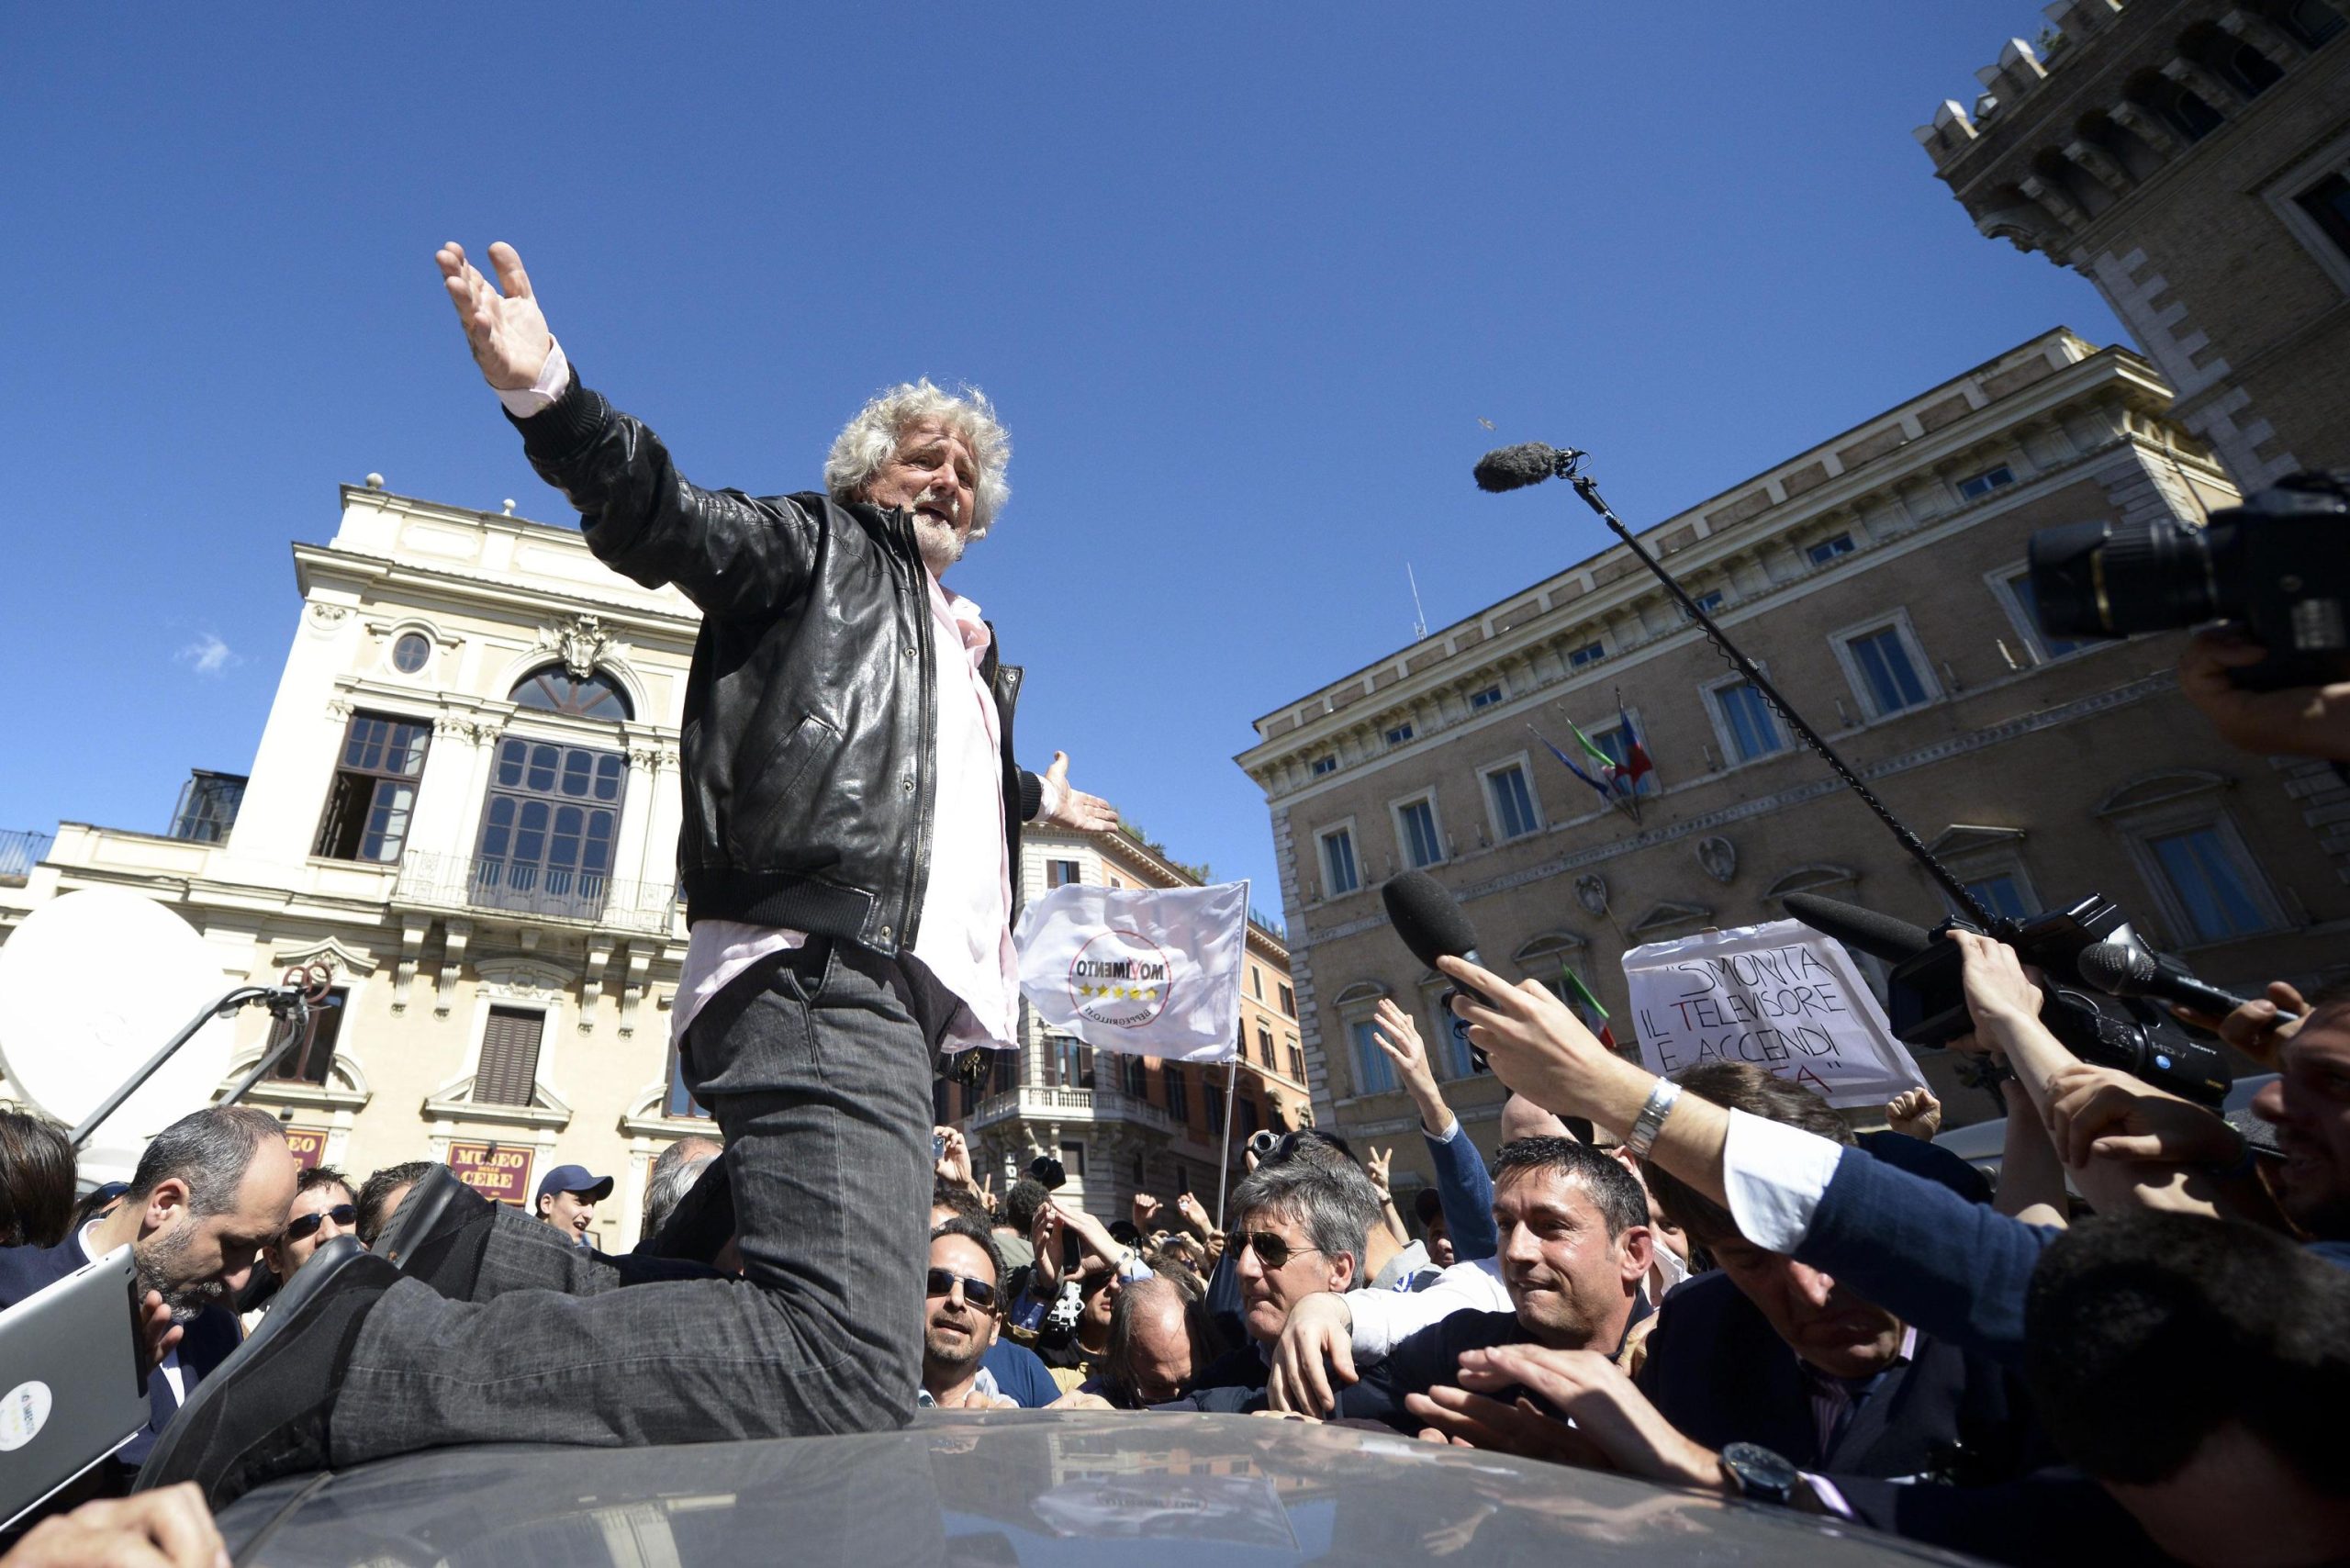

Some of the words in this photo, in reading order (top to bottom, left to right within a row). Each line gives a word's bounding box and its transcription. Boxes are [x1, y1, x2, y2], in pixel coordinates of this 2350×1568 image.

[1640, 1009, 1670, 1039] IL
[1670, 983, 1846, 1031] TELEVISORE
[1658, 1040, 1682, 1072] E
[1699, 1024, 1841, 1065] ACCENDI
[461, 1170, 513, 1189] CERE
